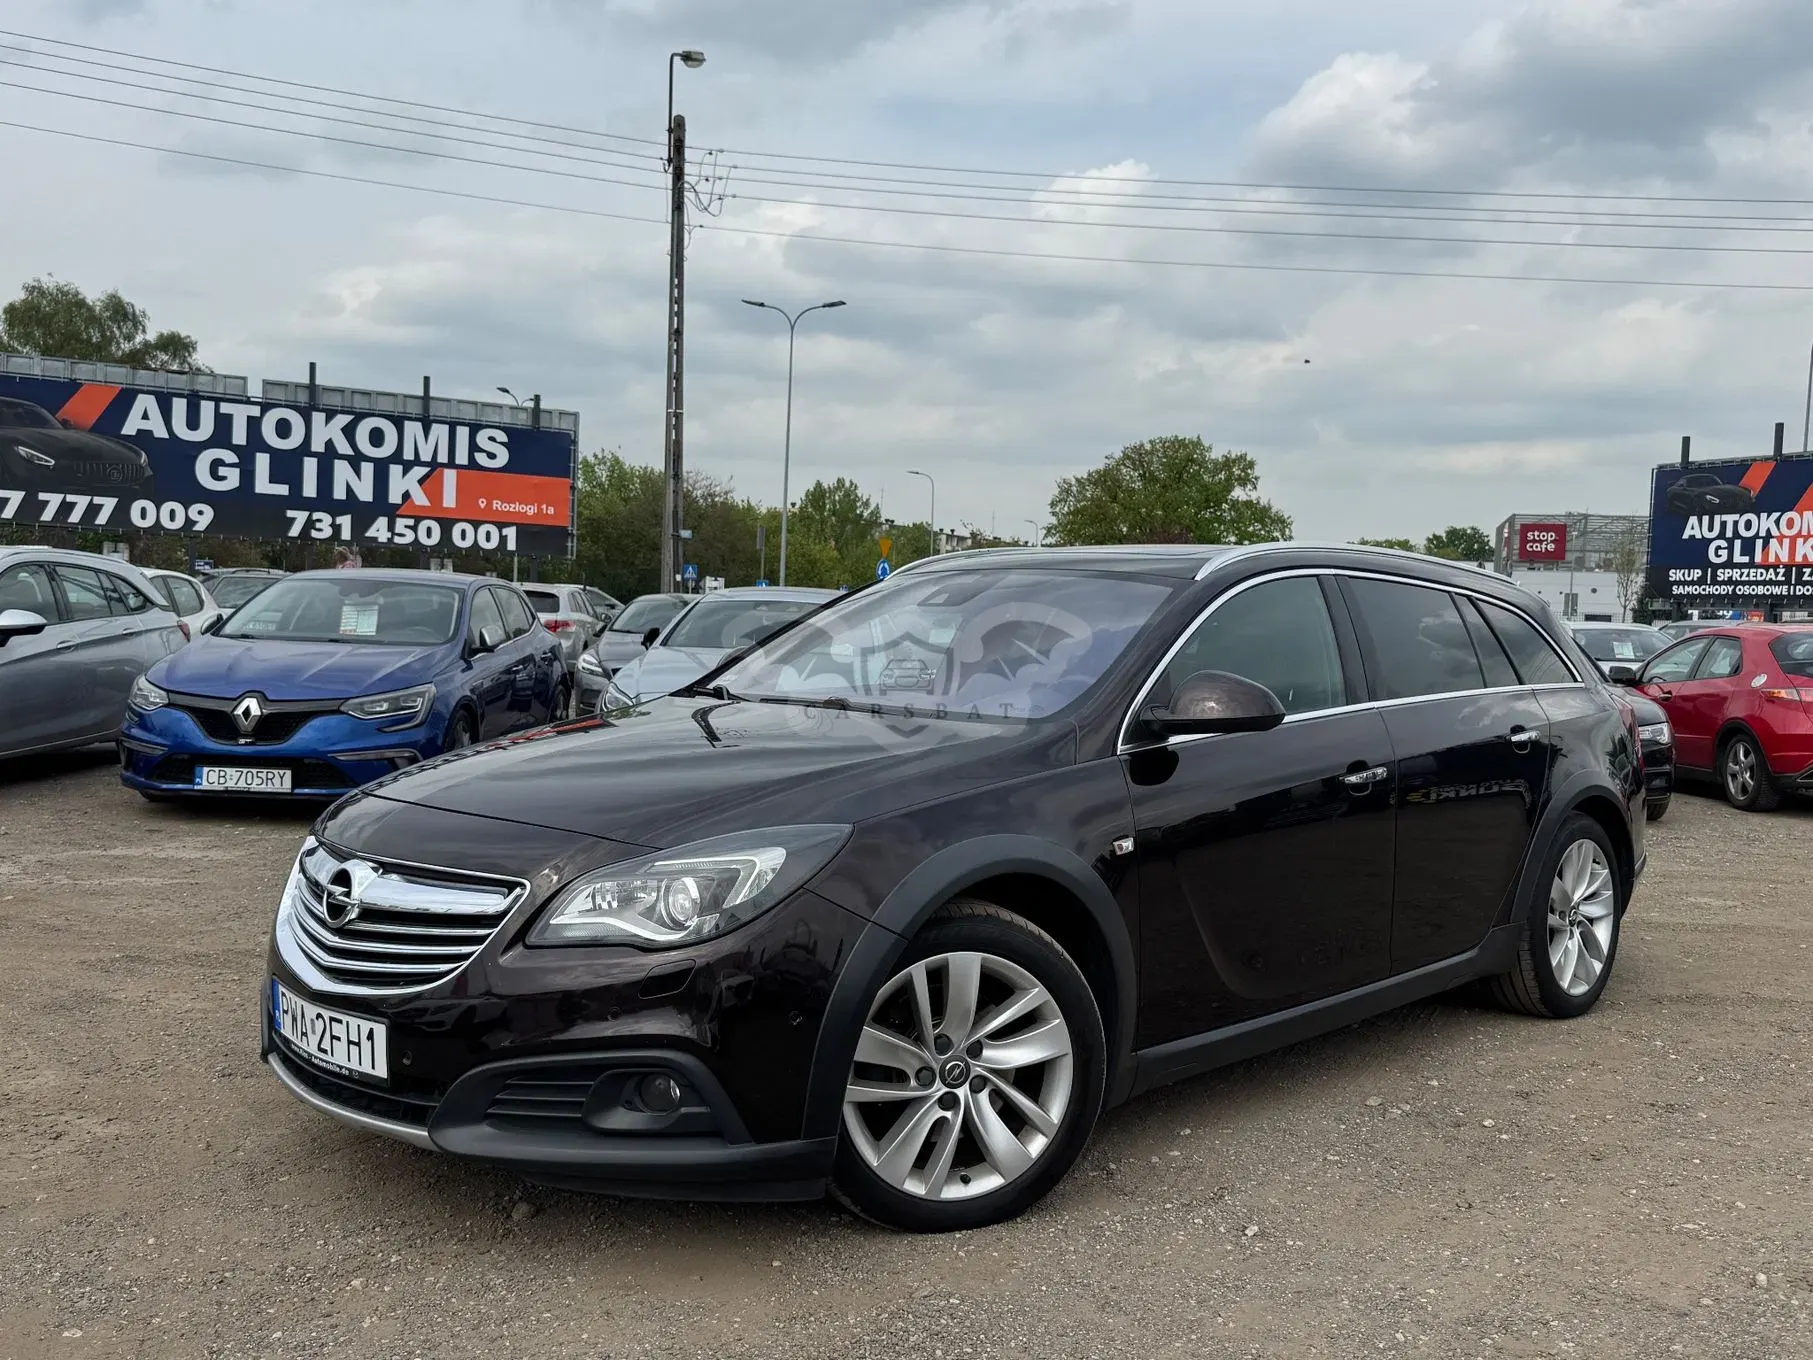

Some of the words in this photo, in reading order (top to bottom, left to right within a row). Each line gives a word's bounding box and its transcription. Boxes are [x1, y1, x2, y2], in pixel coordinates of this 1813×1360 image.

[120, 393, 509, 468] AUTOKOMIS
[195, 448, 457, 508] GLINKI
[38, 491, 119, 525] 777
[130, 499, 214, 531] 009
[541, 504, 554, 514] 1a
[285, 510, 352, 540] 731
[364, 516, 441, 547] 450
[452, 522, 517, 550] 001
[1527, 530, 1555, 543] stop
[1526, 541, 1555, 552] cafe
[1708, 538, 1813, 563] GLINK
[1669, 569, 1702, 581] SKUP
[1716, 565, 1785, 581] SPRZEDAŻ
[1672, 585, 1734, 595] SAMOCHODY
[1736, 585, 1788, 595] OSOBOWE
[1790, 585, 1794, 595] I
[206, 769, 227, 785] CB
[234, 770, 286, 787] 705RY
[281, 991, 309, 1046] PWA
[316, 1012, 375, 1070] 2FH1
